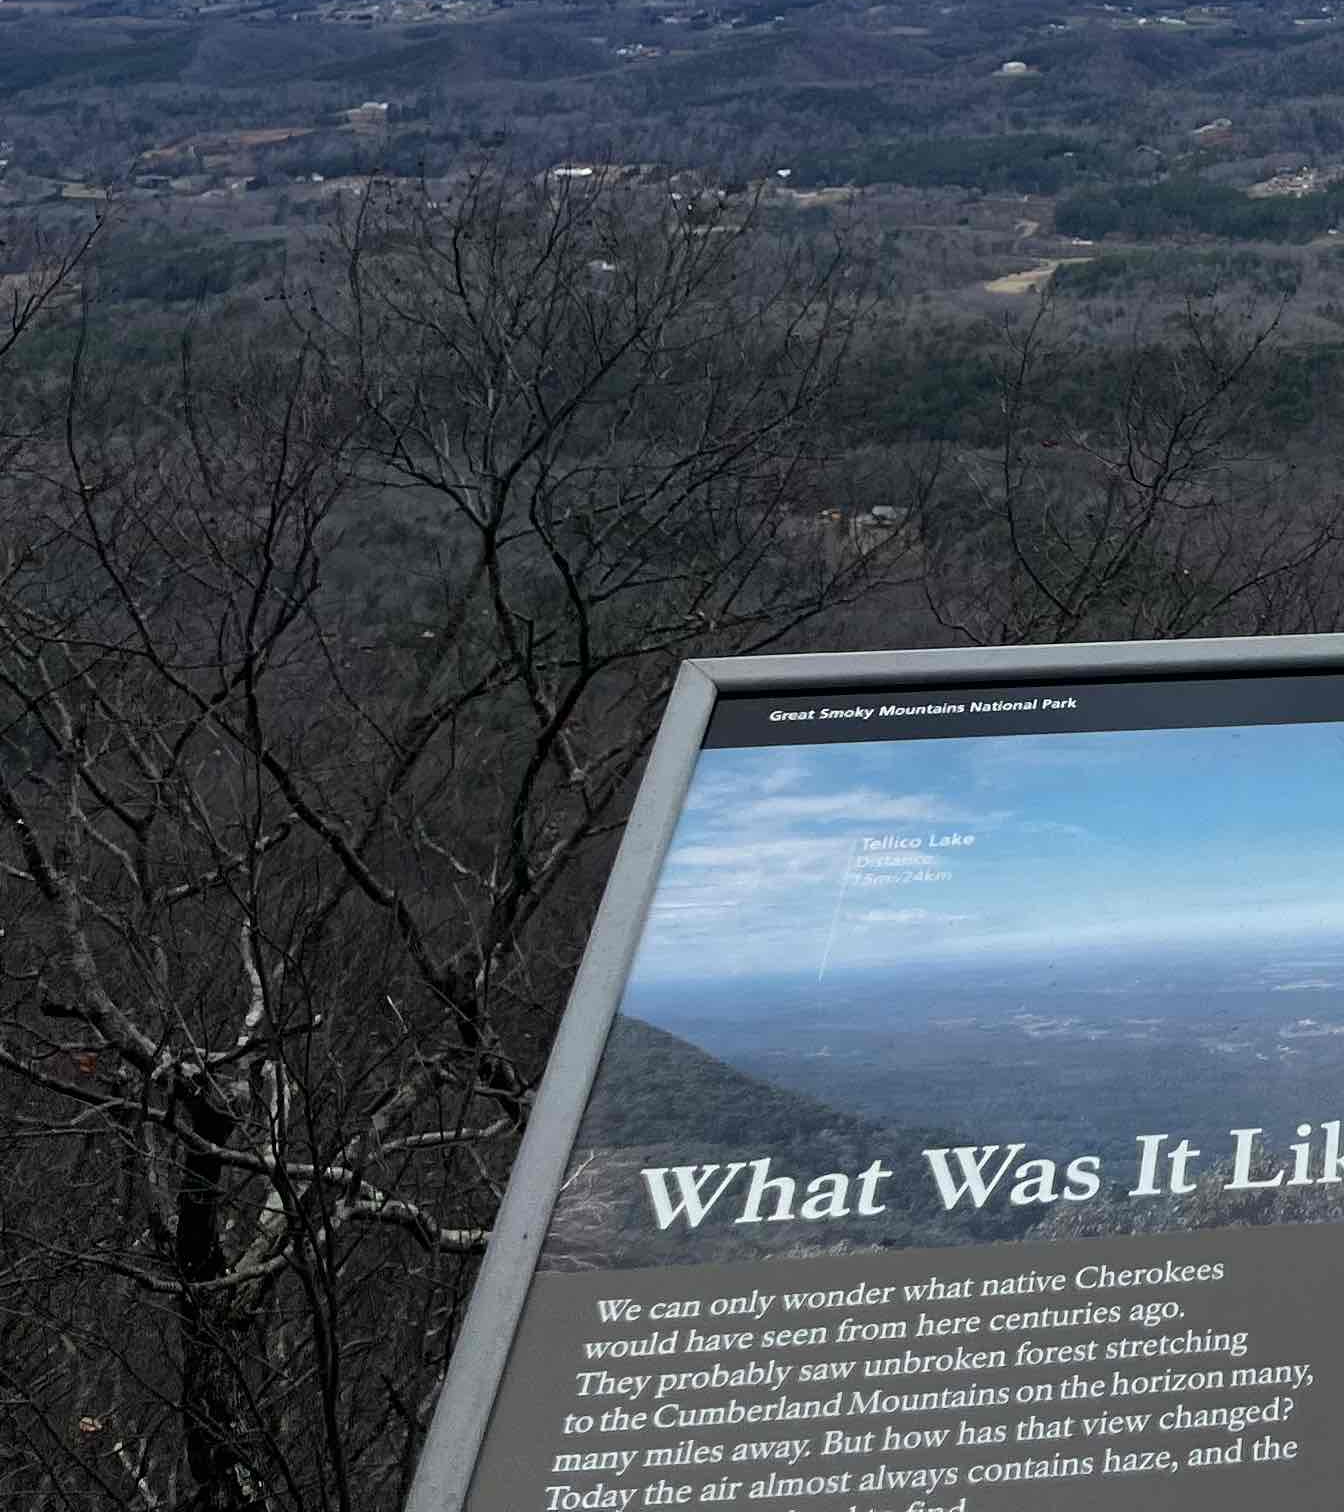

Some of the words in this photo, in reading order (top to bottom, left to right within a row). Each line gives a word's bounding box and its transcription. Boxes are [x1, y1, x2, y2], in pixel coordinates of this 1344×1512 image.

[769, 709, 815, 721] Great
[819, 707, 874, 719] Smoky
[878, 702, 965, 717] Mountains
[969, 699, 1038, 713] National
[1042, 697, 1078, 709] Park
[863, 835, 922, 850] Tellico
[928, 832, 976, 848] Lake
[640, 1157, 894, 1231] What
[921, 1143, 1101, 1211] Was
[1127, 1134, 1201, 1197] It
[596, 1297, 643, 1324] We
[647, 1299, 702, 1321] can
[709, 1288, 777, 1321] only
[782, 1280, 897, 1312] wonder
[902, 1276, 976, 1303] what
[979, 1269, 1067, 1297] native
[1074, 1259, 1225, 1290] Cherokees
[575, 1369, 653, 1401] They
[653, 1359, 795, 1400] probably
[797, 1360, 858, 1383] saw
[863, 1345, 1007, 1378] unbroken
[1013, 1339, 1100, 1368] forest
[1104, 1327, 1250, 1360] stretching
[584, 1329, 680, 1360] would
[683, 1328, 755, 1354] have
[760, 1326, 828, 1349] seen
[834, 1317, 908, 1344] from
[914, 1312, 982, 1338] here
[988, 1301, 1122, 1332] centuries
[1128, 1301, 1186, 1328] ago.
[550, 1449, 640, 1477] many
[641, 1438, 725, 1468] miles
[730, 1438, 812, 1466] away.
[819, 1429, 877, 1456] But
[879, 1425, 952, 1452] how
[955, 1419, 1008, 1447] has
[1015, 1414, 1076, 1442] that
[1081, 1409, 1153, 1437] view
[1158, 1395, 1295, 1433] changed?
[544, 1482, 639, 1512] Today
[643, 1478, 693, 1506] the
[698, 1475, 744, 1503] air
[747, 1470, 854, 1500] almost
[857, 1463, 959, 1495] always
[967, 1451, 1095, 1485] contains
[1100, 1447, 1179, 1475] haze,
[1186, 1437, 1243, 1468] and
[1251, 1434, 1299, 1463] the
